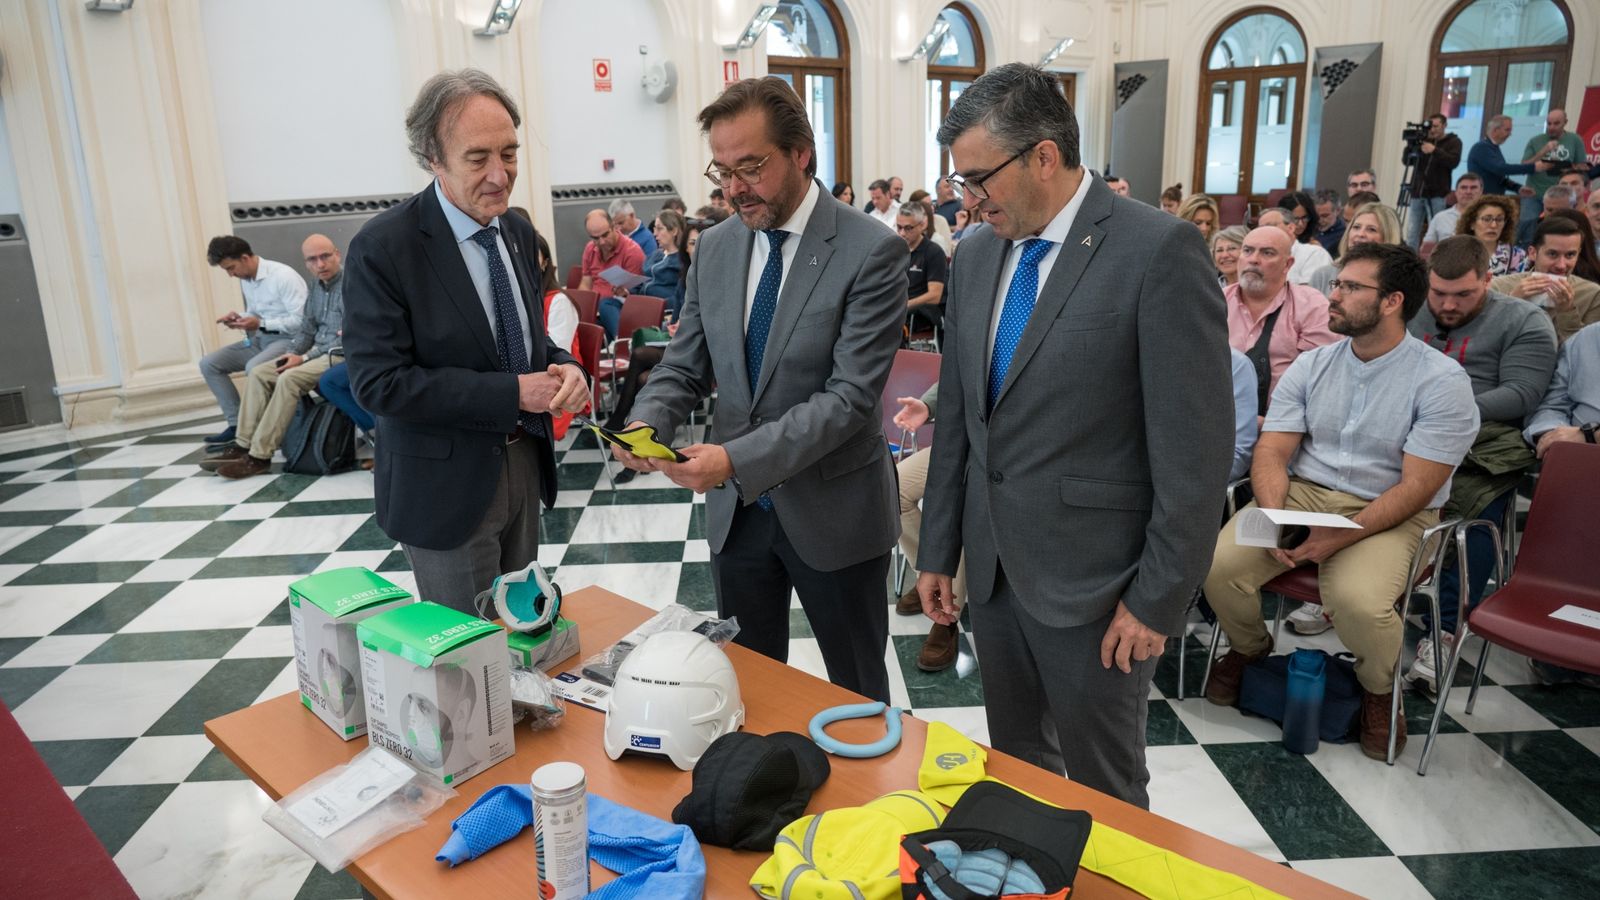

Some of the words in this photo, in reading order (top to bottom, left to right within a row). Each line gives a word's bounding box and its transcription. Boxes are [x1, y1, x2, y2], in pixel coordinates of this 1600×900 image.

[441, 623, 469, 637] ZERO
[425, 633, 444, 645] 32
[320, 696, 327, 711] 32
[372, 731, 385, 747] BLS
[386, 738, 402, 755] ZERO
[403, 746, 413, 761] 32
